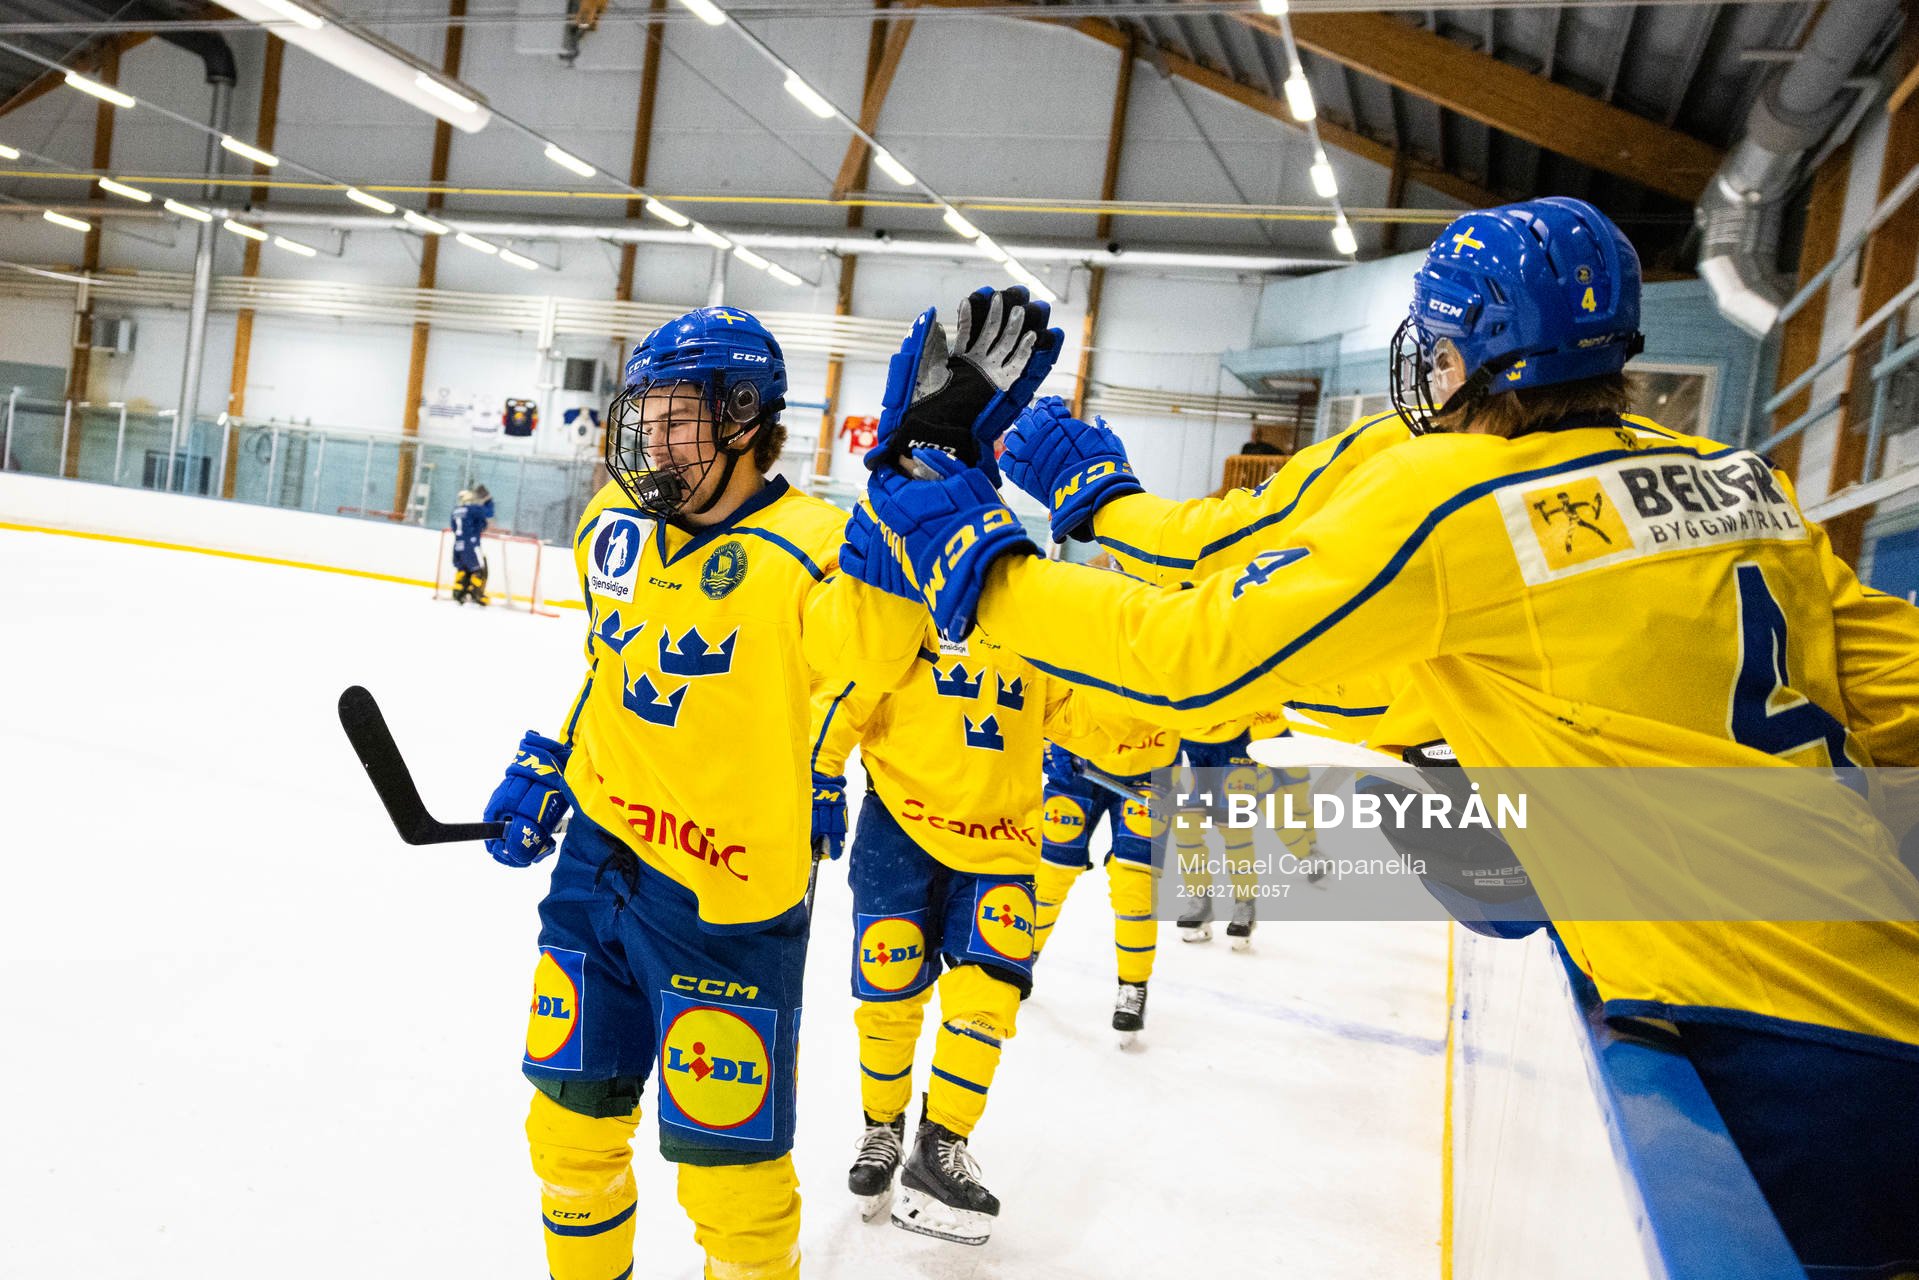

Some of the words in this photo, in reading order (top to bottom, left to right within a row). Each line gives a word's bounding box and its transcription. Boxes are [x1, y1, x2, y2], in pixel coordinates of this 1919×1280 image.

[1429, 300, 1463, 317] CCM
[1581, 287, 1598, 312] 4
[628, 355, 652, 374] CCM
[732, 352, 768, 364] CCM
[923, 509, 1014, 612] CCM
[1232, 547, 1311, 601] 4
[591, 576, 629, 596] Gjensidige
[648, 577, 683, 591] CCM
[671, 974, 759, 999] CCM
[552, 1209, 591, 1220] CCM
